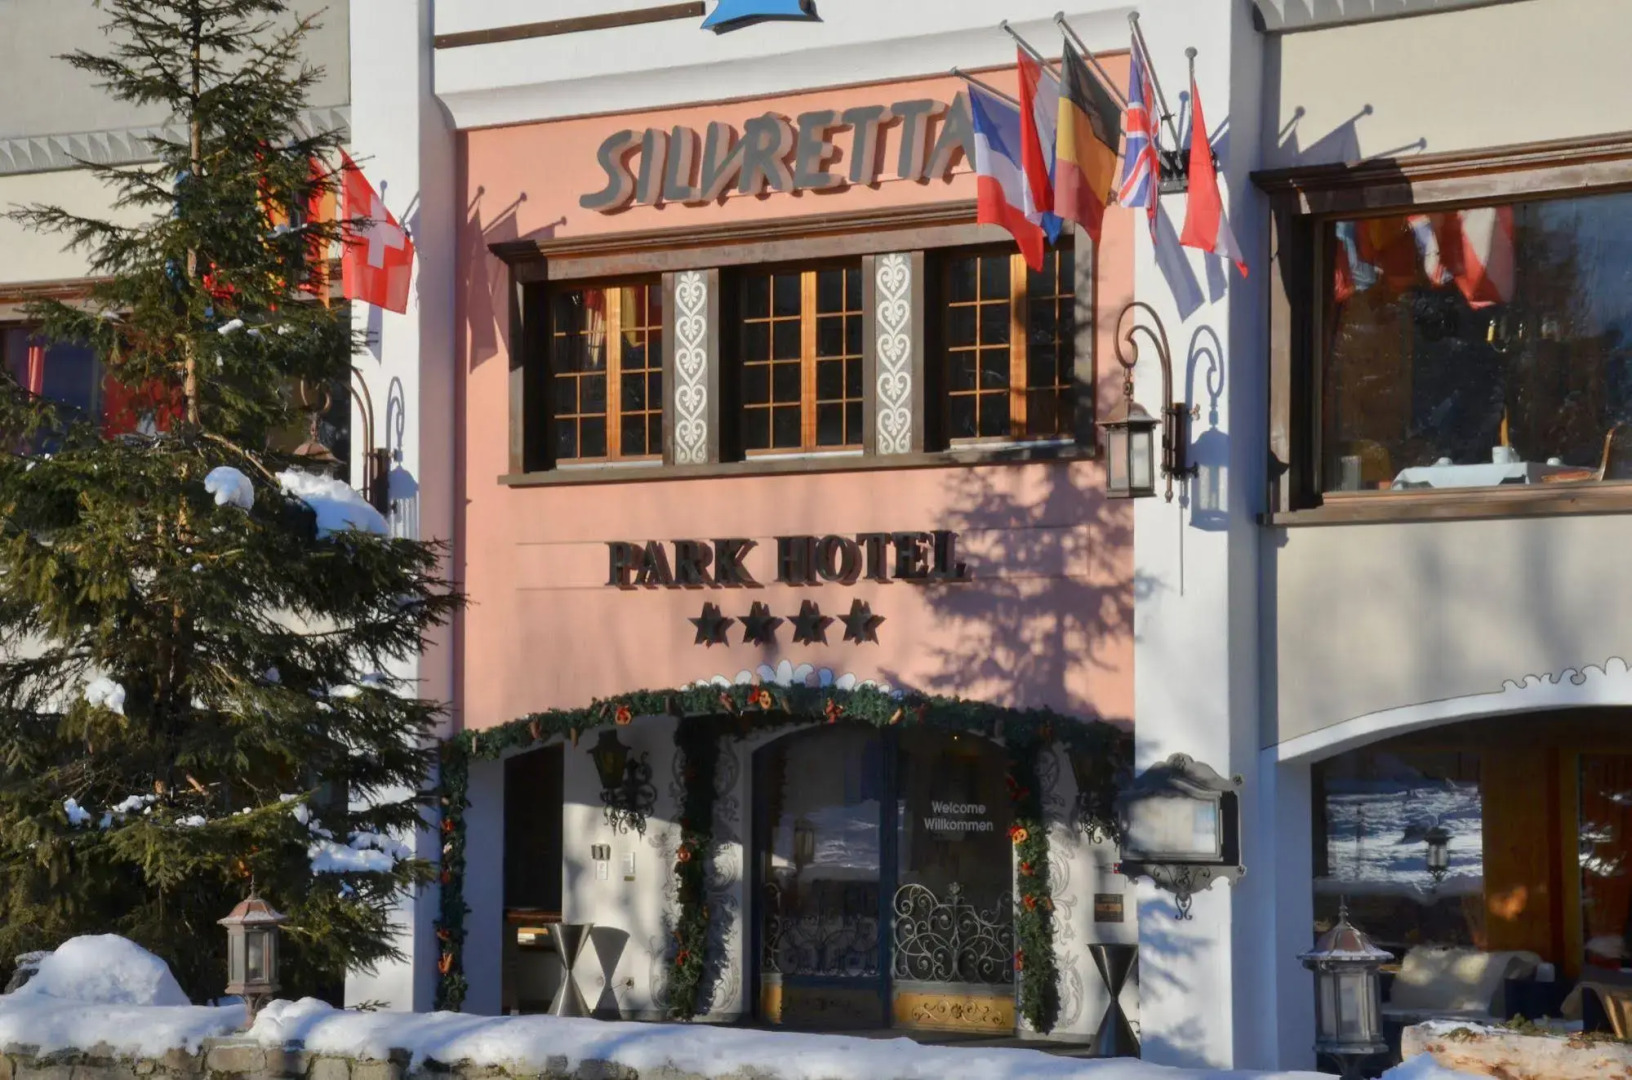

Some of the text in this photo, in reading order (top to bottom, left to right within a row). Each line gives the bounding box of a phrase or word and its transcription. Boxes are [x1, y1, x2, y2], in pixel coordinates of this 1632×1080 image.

[580, 92, 976, 210] SILVRETTA
[605, 530, 970, 589] PARK HOTEL
[923, 818, 993, 831] Willkommen
[931, 801, 986, 814] Welcome
